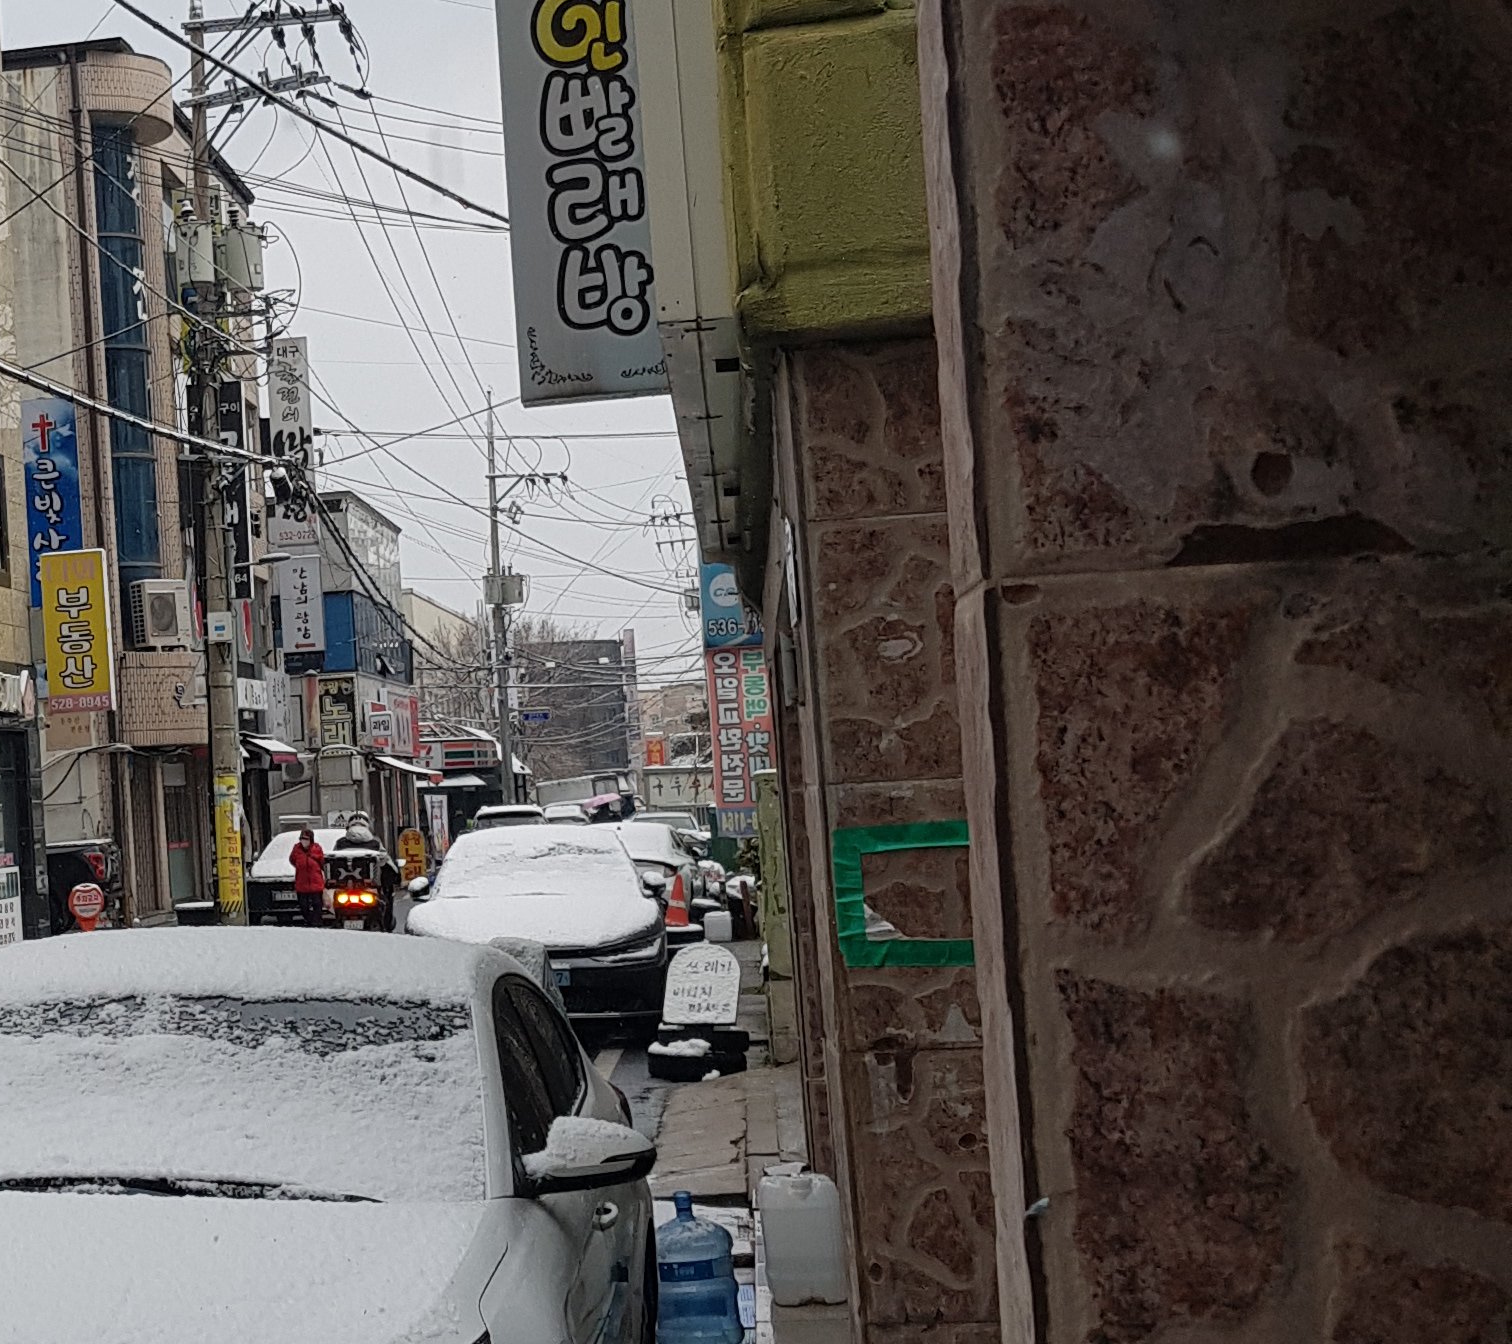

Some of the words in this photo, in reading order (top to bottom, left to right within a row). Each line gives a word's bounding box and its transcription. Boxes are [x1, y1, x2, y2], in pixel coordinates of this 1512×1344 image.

[277, 346, 299, 358] 대구
[32, 458, 68, 582] 큰빛사
[55, 585, 97, 690] 부동산
[320, 695, 353, 747] 노래
